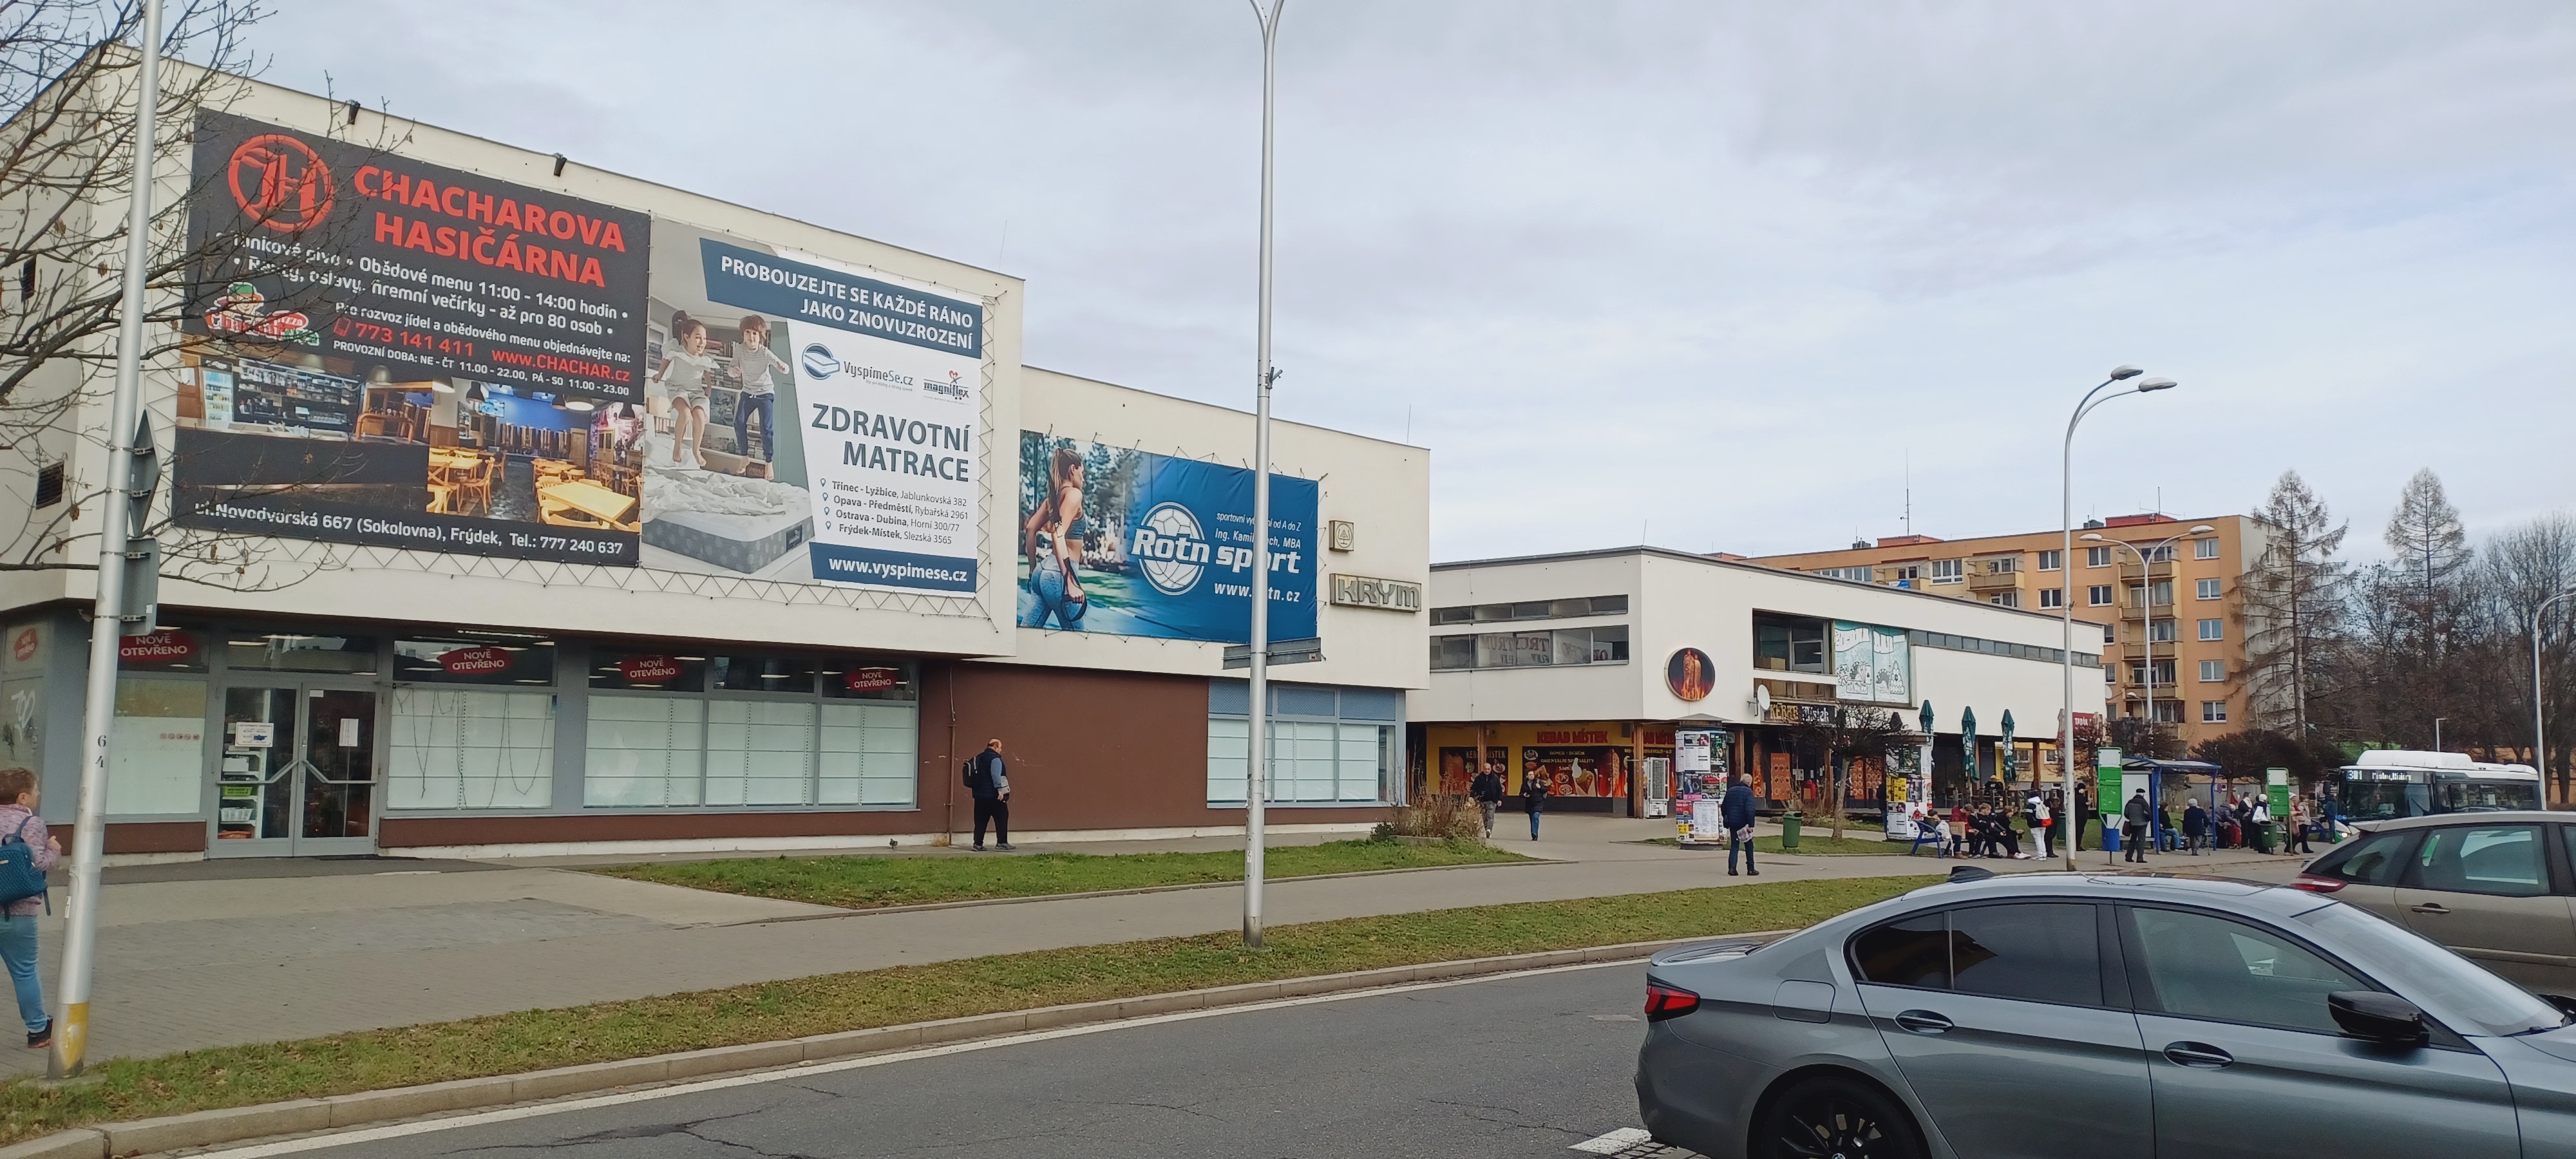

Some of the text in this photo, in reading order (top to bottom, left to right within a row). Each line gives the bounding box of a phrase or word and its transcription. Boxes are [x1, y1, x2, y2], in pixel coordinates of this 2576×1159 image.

[354, 165, 625, 252] CHACHAROVA
[375, 211, 605, 288] HASIČÁRNA
[359, 256, 428, 283] Obědové
[431, 274, 473, 292] menu
[478, 281, 520, 301] 11:00
[536, 292, 576, 311] 14:00
[580, 299, 617, 319] hodin
[721, 255, 973, 328] PROBOUZEJTE SE KAŽDÉ RÁNO
[431, 293, 486, 317] večírky
[499, 305, 516, 320] až
[520, 311, 544, 325] pro
[547, 314, 566, 329] 80
[570, 319, 602, 335] osob
[800, 297, 972, 350] JAKO ZNOVUZROZENÍ
[355, 322, 473, 357] 773 141 411
[361, 307, 402, 324] rozvoz
[404, 313, 431, 330] jídel
[433, 321, 440, 330] a
[443, 323, 506, 343] obědového
[509, 334, 540, 348] menu
[543, 338, 612, 361] objednávejte
[614, 352, 631, 363] na:
[333, 339, 385, 357] PROVOZNÍ
[387, 349, 418, 363] DOBA:
[420, 355, 434, 366] NE
[442, 356, 455, 368] ČT
[459, 361, 488, 374] 11.00
[497, 367, 527, 382] 22.00,
[532, 372, 544, 383] PÁ
[551, 375, 564, 386] SO
[568, 378, 595, 391] 11.00
[603, 384, 629, 396] 23.00
[491, 349, 630, 382] www.CHACHAR.cz
[844, 361, 913, 386] VyspimeSe.cz
[923, 381, 969, 399] magniflex
[811, 402, 971, 452] ZDRAVOTNÍ
[843, 440, 969, 482] MATRACE
[832, 480, 859, 493] Třinec
[866, 485, 899, 500] Lyžbice,
[900, 490, 951, 506] Jablunkovská
[953, 497, 967, 507] 382
[833, 495, 862, 508] Opava
[869, 500, 913, 515] Předměstí,
[914, 505, 949, 519] Rybařská
[951, 511, 968, 520] 2961
[835, 509, 869, 522] Ostrava
[876, 514, 909, 527] Dubina,
[911, 518, 933, 530] Horní
[933, 521, 960, 532] 300/77
[1217, 512, 1246, 524] sportovní
[1273, 519, 1282, 529] od
[1282, 520, 1287, 529] A
[1288, 522, 1296, 531] do
[1296, 522, 1302, 532] Z
[322, 514, 353, 530] 667
[356, 518, 446, 542] (Sokolovna),
[450, 527, 502, 546] Frýdek,
[509, 532, 536, 548] Tel.:
[540, 536, 566, 549] 777
[569, 539, 594, 553] 240
[598, 541, 623, 554] 637
[838, 523, 952, 545] Frýdek-Místek, Slezská 3565
[1132, 528, 1210, 563] Rotn
[1215, 528, 1230, 542] Ing.
[1283, 537, 1301, 549] MBA
[828, 557, 967, 582] www.vyspimese.cz
[1215, 583, 1300, 603] www.tn.cz
[120, 644, 188, 657] OTEVŘENO
[136, 632, 171, 645] NOVĚ
[452, 659, 505, 670] OTEVŘENO
[464, 648, 491, 660] NOVĚ
[639, 657, 664, 668] NOVĚ
[630, 667, 676, 678] OTEVŘENO
[854, 678, 891, 688] OTEVŘENO
[862, 670, 882, 679] NOVĚ
[1537, 728, 1609, 744] KEBAB MÍSTEK
[1655, 729, 1675, 744] MÍSTE
